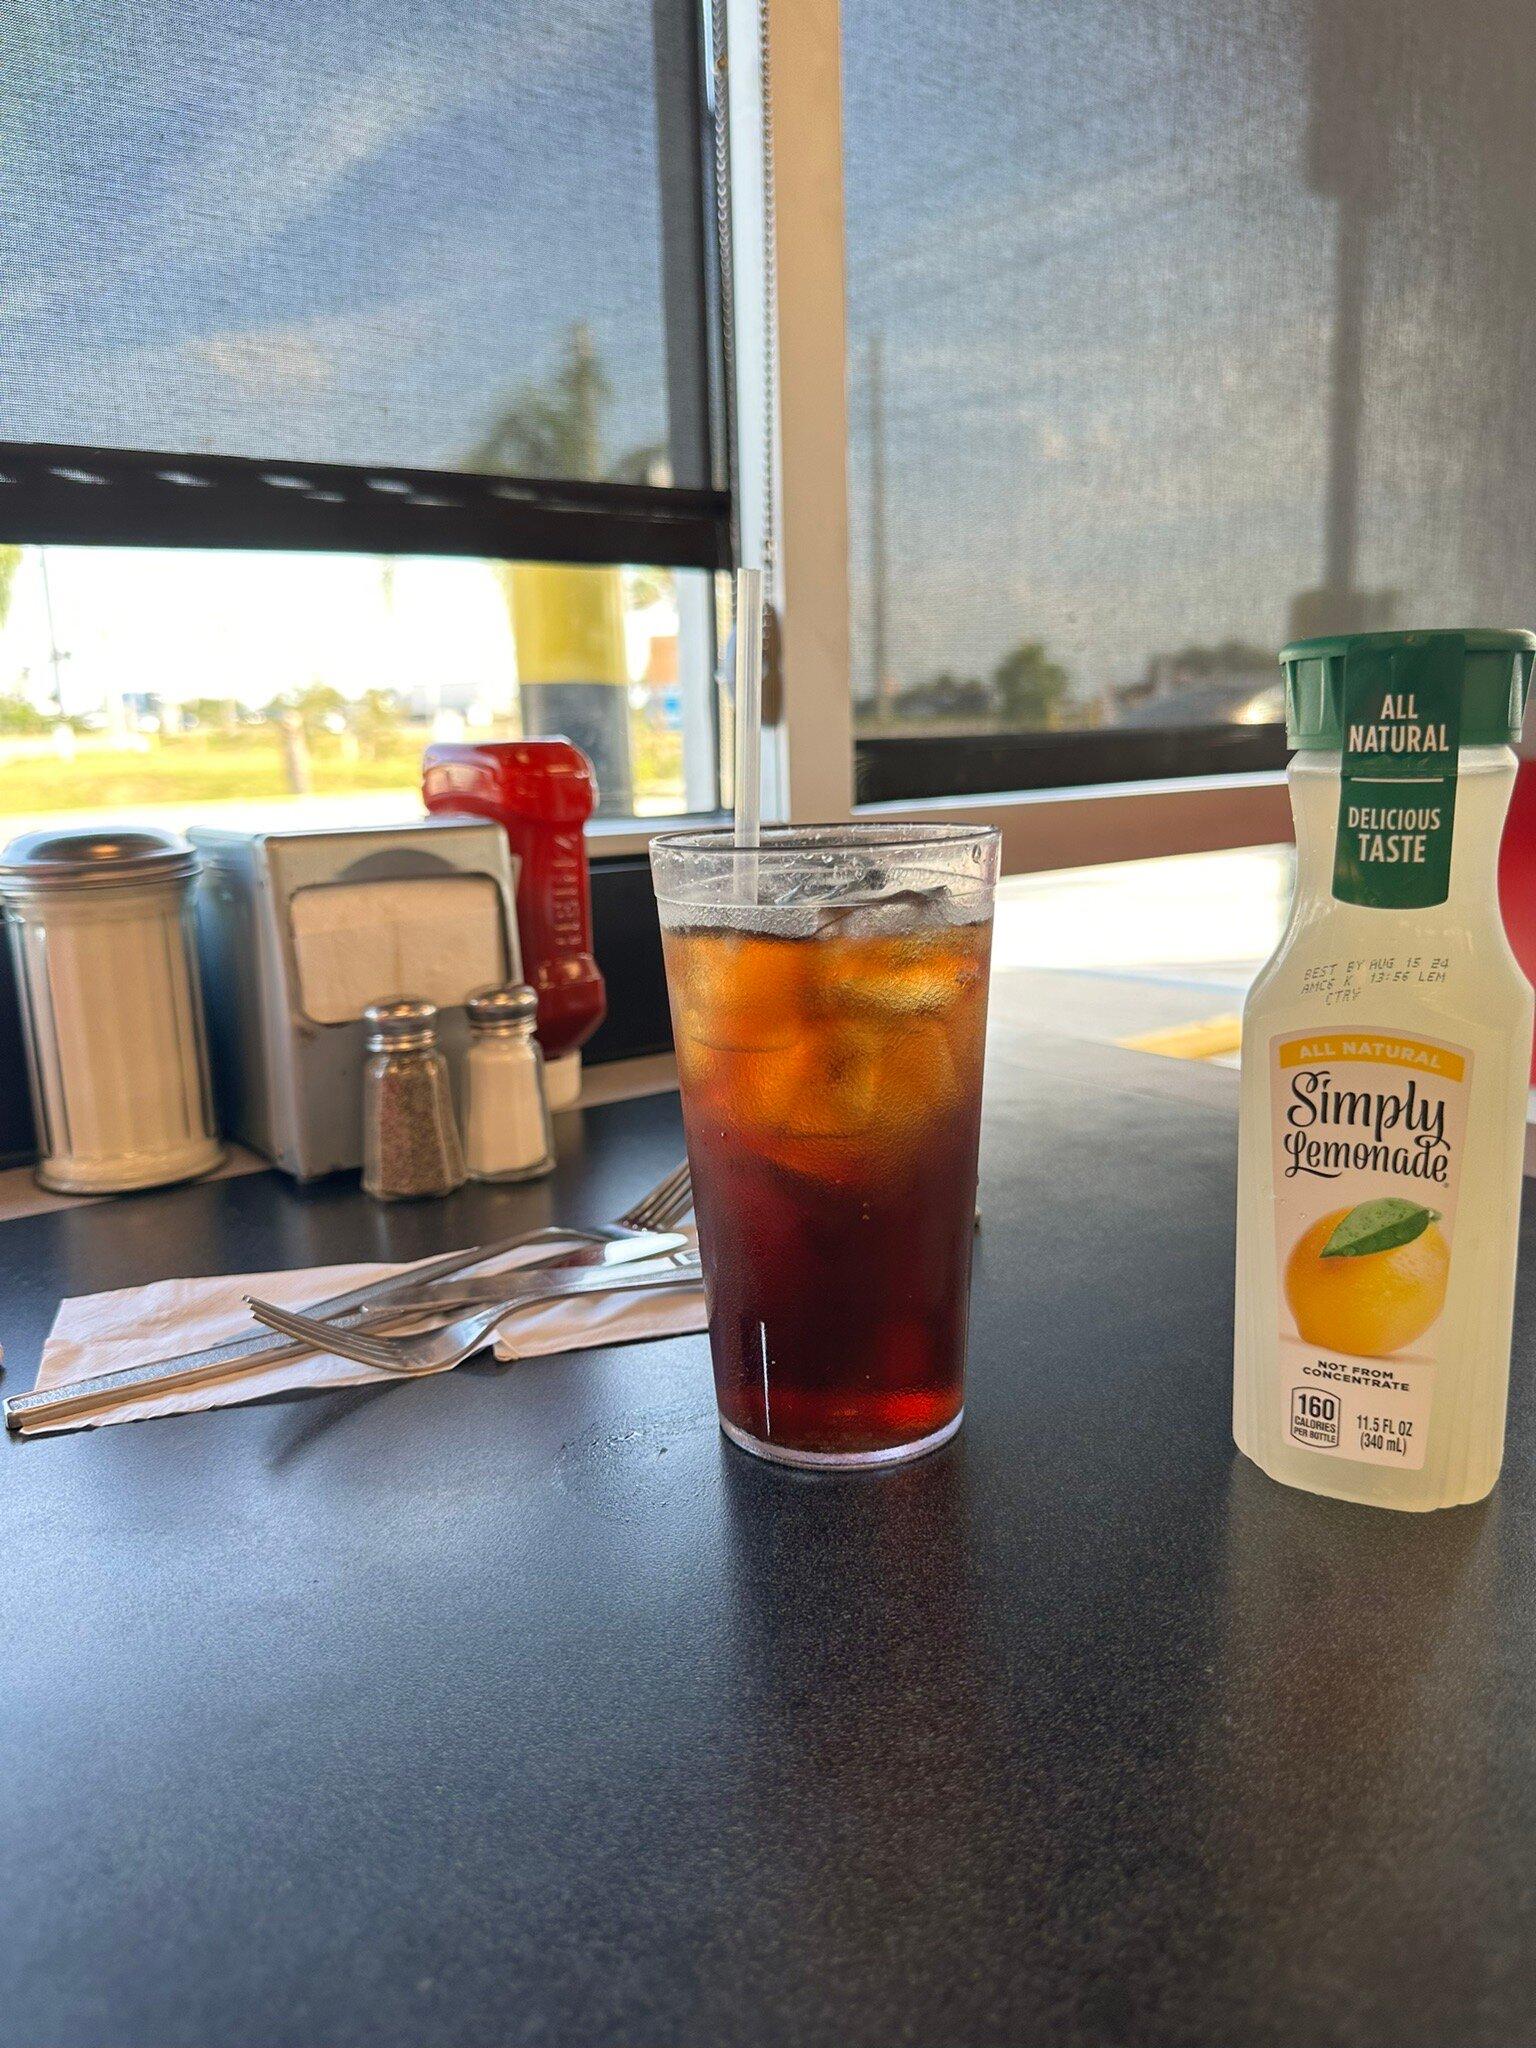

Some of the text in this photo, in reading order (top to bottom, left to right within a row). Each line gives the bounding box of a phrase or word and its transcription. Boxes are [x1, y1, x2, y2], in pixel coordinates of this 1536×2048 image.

[1380, 694, 1418, 720] ALL
[1349, 724, 1450, 753] NATURAL
[1347, 806, 1441, 831] DELICIOUS
[1358, 833, 1427, 863] TASTE
[1304, 957, 1450, 981] BEST BY AUG 15 24
[1418, 971, 1446, 983] LEM
[1300, 1041, 1442, 1069] ALL NATURAL
[1286, 1070, 1451, 1151] Simply
[1283, 1130, 1449, 1183] Lemonade
[1302, 1366, 1410, 1391] CONCENTRATE
[1317, 1360, 1394, 1379] NOT FROM
[1298, 1393, 1335, 1421] 160
[1293, 1427, 1336, 1444] PER BOTTLE
[1294, 1415, 1336, 1433] CALORIES
[1357, 1414, 1413, 1437] 11.5 FL OZ
[1360, 1432, 1407, 1456] (340 mL)
